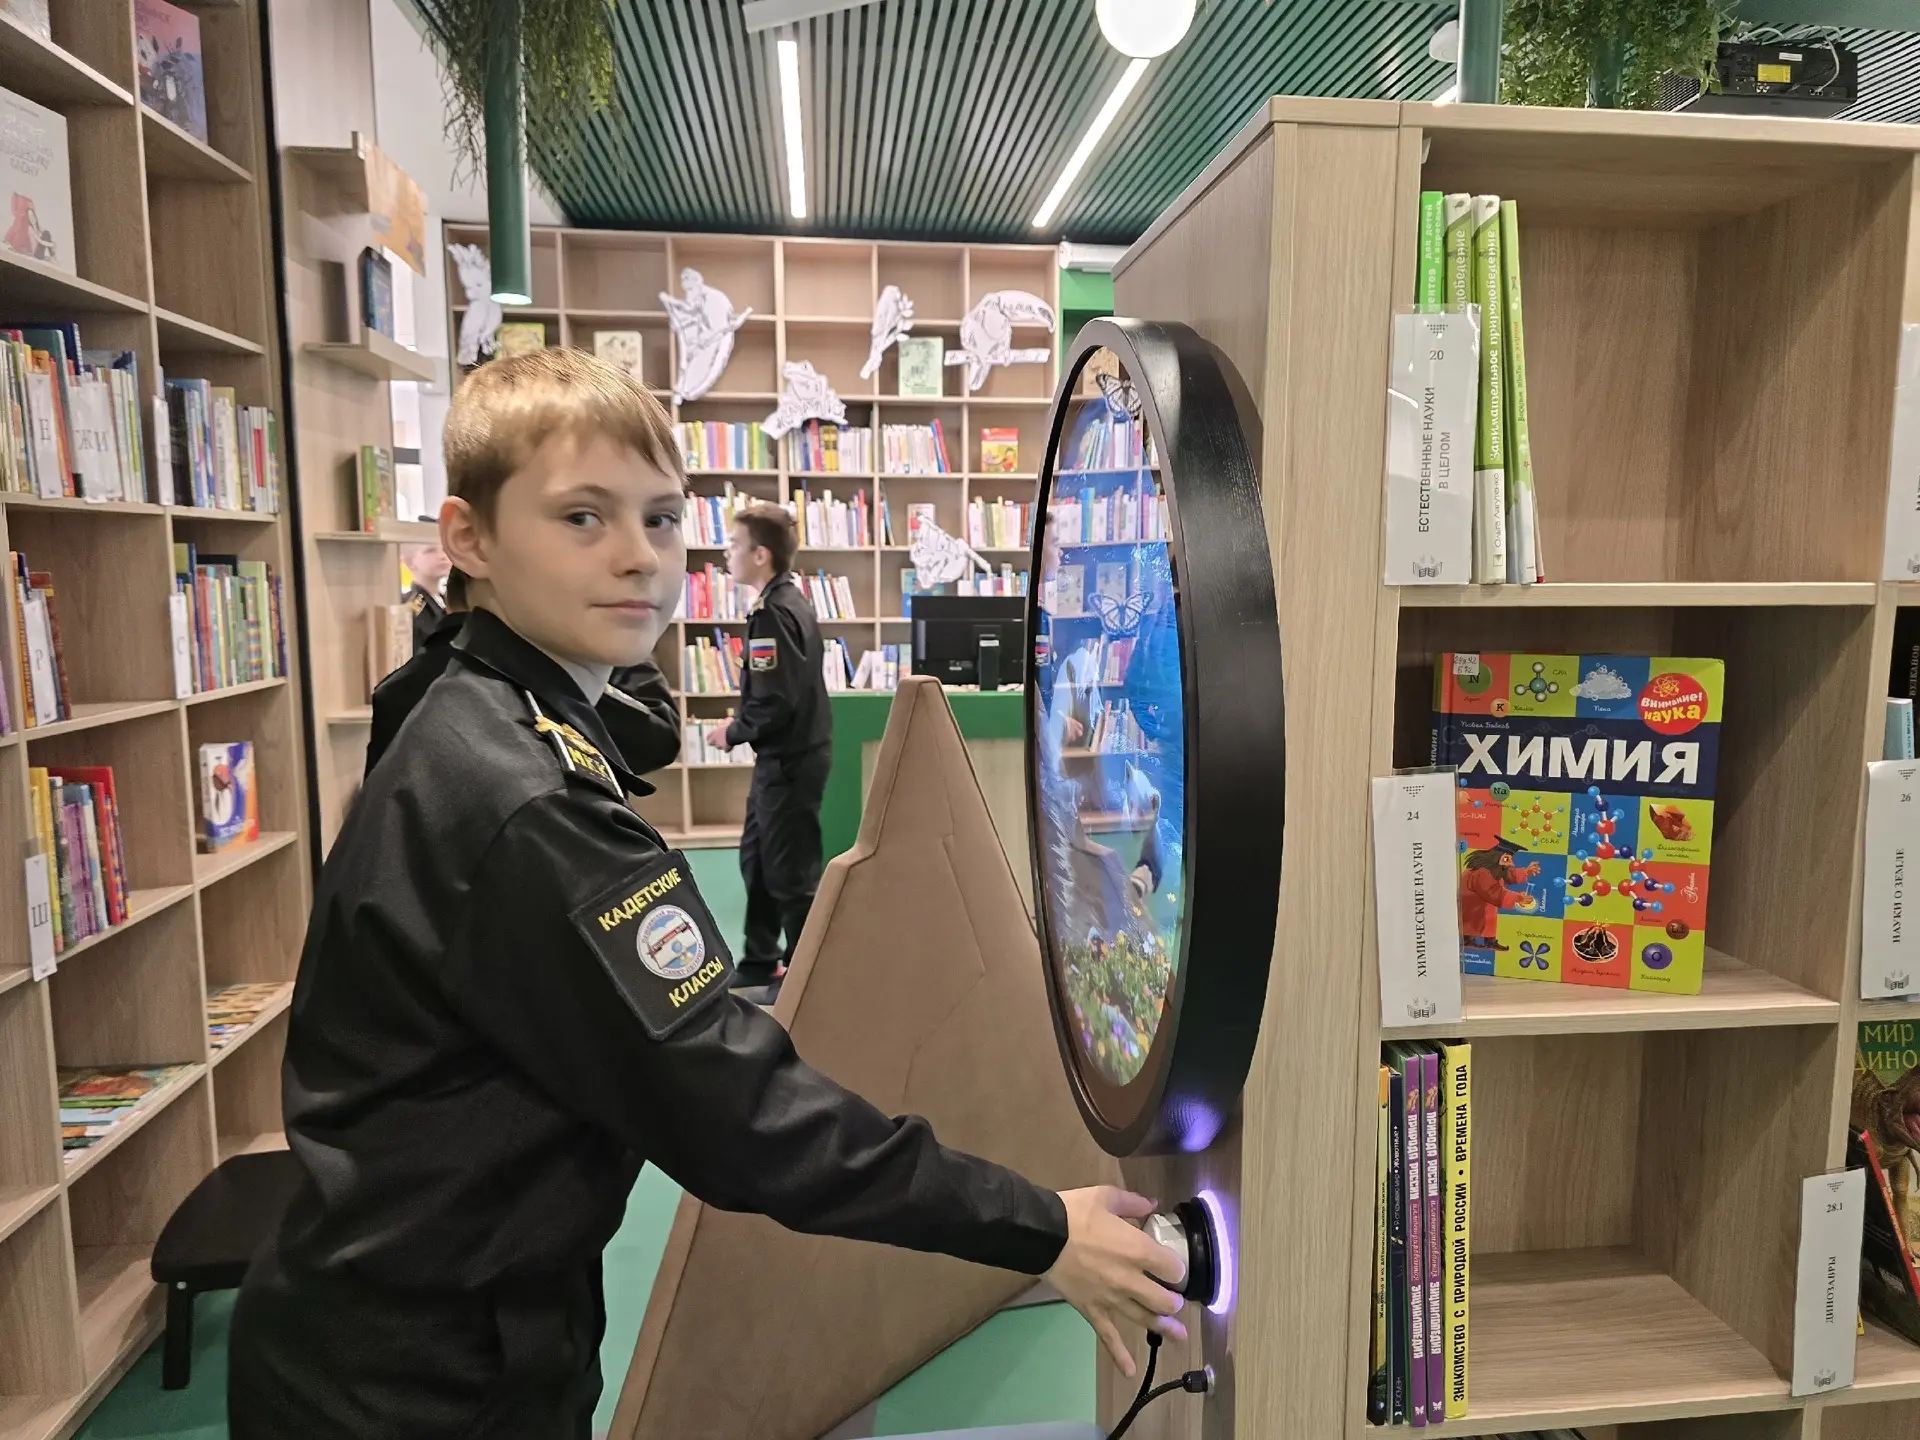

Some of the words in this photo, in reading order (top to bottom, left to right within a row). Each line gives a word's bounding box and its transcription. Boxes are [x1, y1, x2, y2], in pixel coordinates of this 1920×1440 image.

[1424, 204, 1433, 236] детей
[1487, 230, 1500, 345] природоведение
[1430, 350, 1444, 360] 20
[1423, 387, 1436, 430] НАУКИ
[1490, 350, 1501, 460] Занимательное
[1440, 431, 1451, 477] ЦЕЛОМ
[1418, 432, 1433, 533] ЕСТЕСТВЕННЫЕ
[1493, 473, 1502, 519] Лагутенко
[1493, 522, 1502, 548] Ольга
[1458, 733, 1700, 785] ХИМИЯ
[1493, 787, 1507, 795] Na
[1901, 793, 1911, 802] 26
[1406, 811, 1420, 821] 24
[1413, 842, 1424, 886] НАУКИ
[1895, 848, 1904, 889] ЗЕМЛЕ
[598, 867, 682, 932] КАДЕТСКИЕ
[1894, 890, 1903, 899] О
[1414, 890, 1427, 977] ХИМИЧЕСКИЕ
[1892, 902, 1902, 943] НАУКИ
[668, 956, 724, 1008] КЛАССЫ
[1455, 1064, 1467, 1097] ГОДА
[1407, 1114, 1419, 1160] ПРИРОДА
[1426, 1111, 1437, 1157] ПРИРОДА
[1455, 1103, 1467, 1163] ВРЕМЕНА
[1409, 1162, 1419, 1200] РОССИИ
[1428, 1160, 1438, 1197] РОССИИ
[1454, 1182, 1467, 1232] РОССИИ
[1826, 1202, 1843, 1213] 28.1
[1452, 1238, 1466, 1304] ПРИРОДОЙ
[1825, 1255, 1837, 1324] ДИНОЗАВРЫ
[1411, 1284, 1424, 1359] ЭНЦИКЛОПЕДИЯ
[1430, 1281, 1442, 1355] ЭНЦИКЛОПЕДИЯ
[1454, 1309, 1466, 1319] С
[1453, 1324, 1466, 1402] ЗНАКОМСТВО
